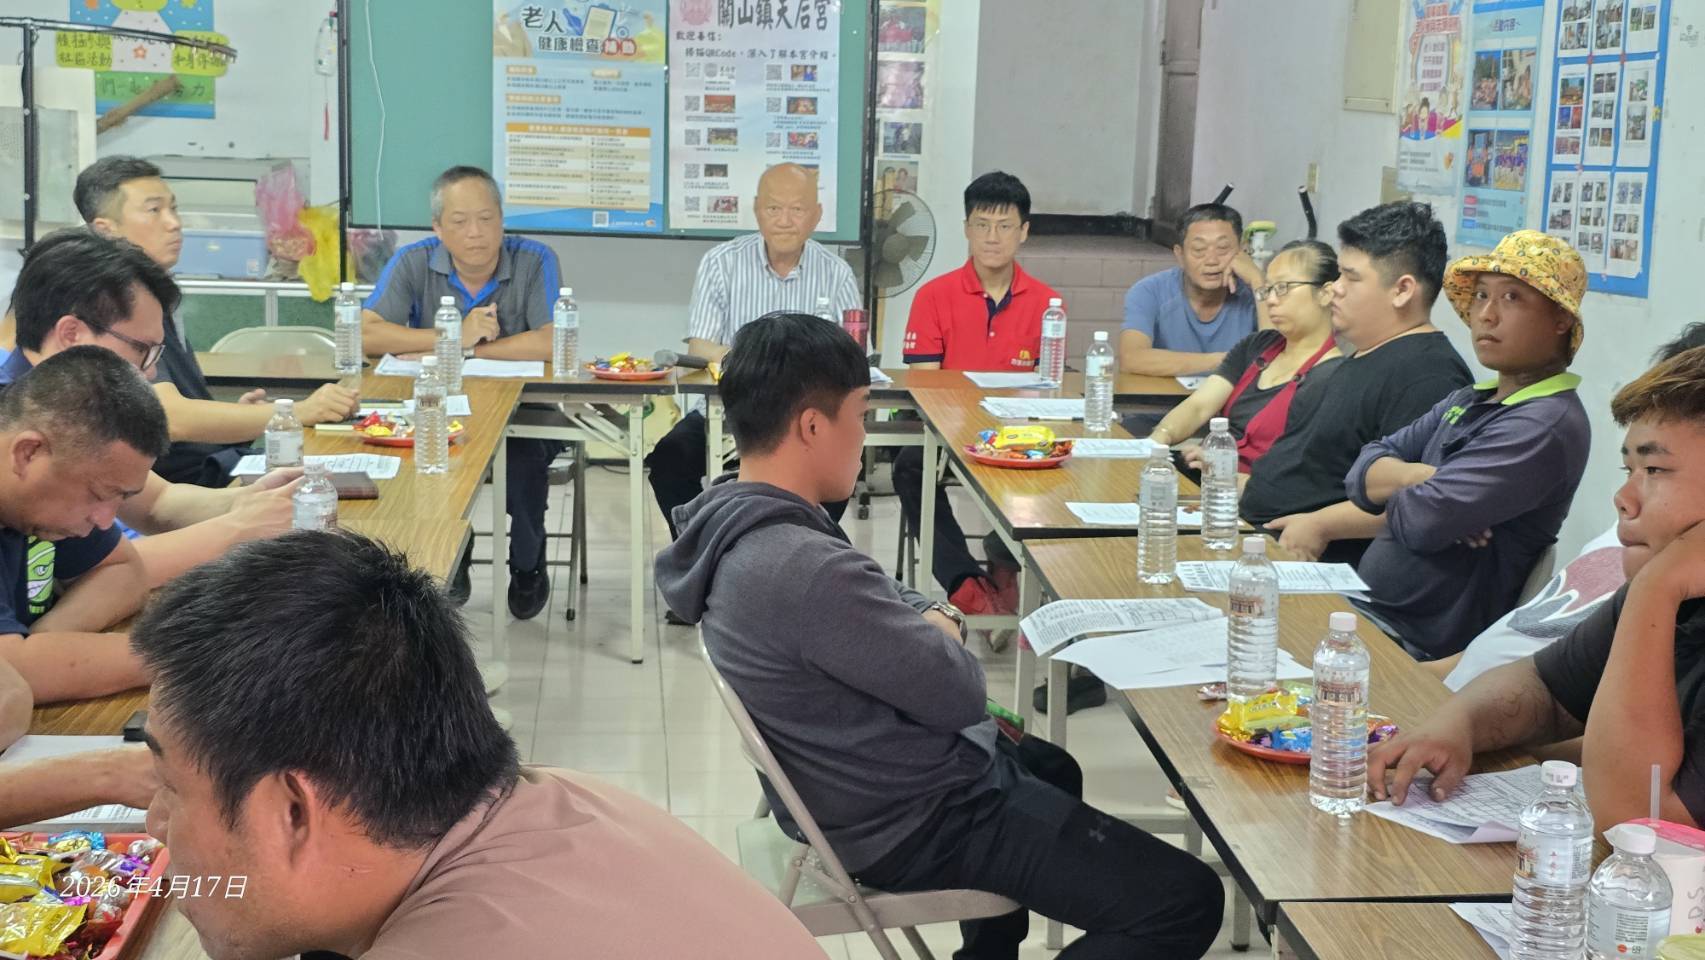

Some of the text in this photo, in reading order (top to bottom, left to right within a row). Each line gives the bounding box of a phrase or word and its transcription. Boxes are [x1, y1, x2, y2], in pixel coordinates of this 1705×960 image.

[522, 6, 565, 33] 老人
[538, 36, 637, 56] 健康檢查
